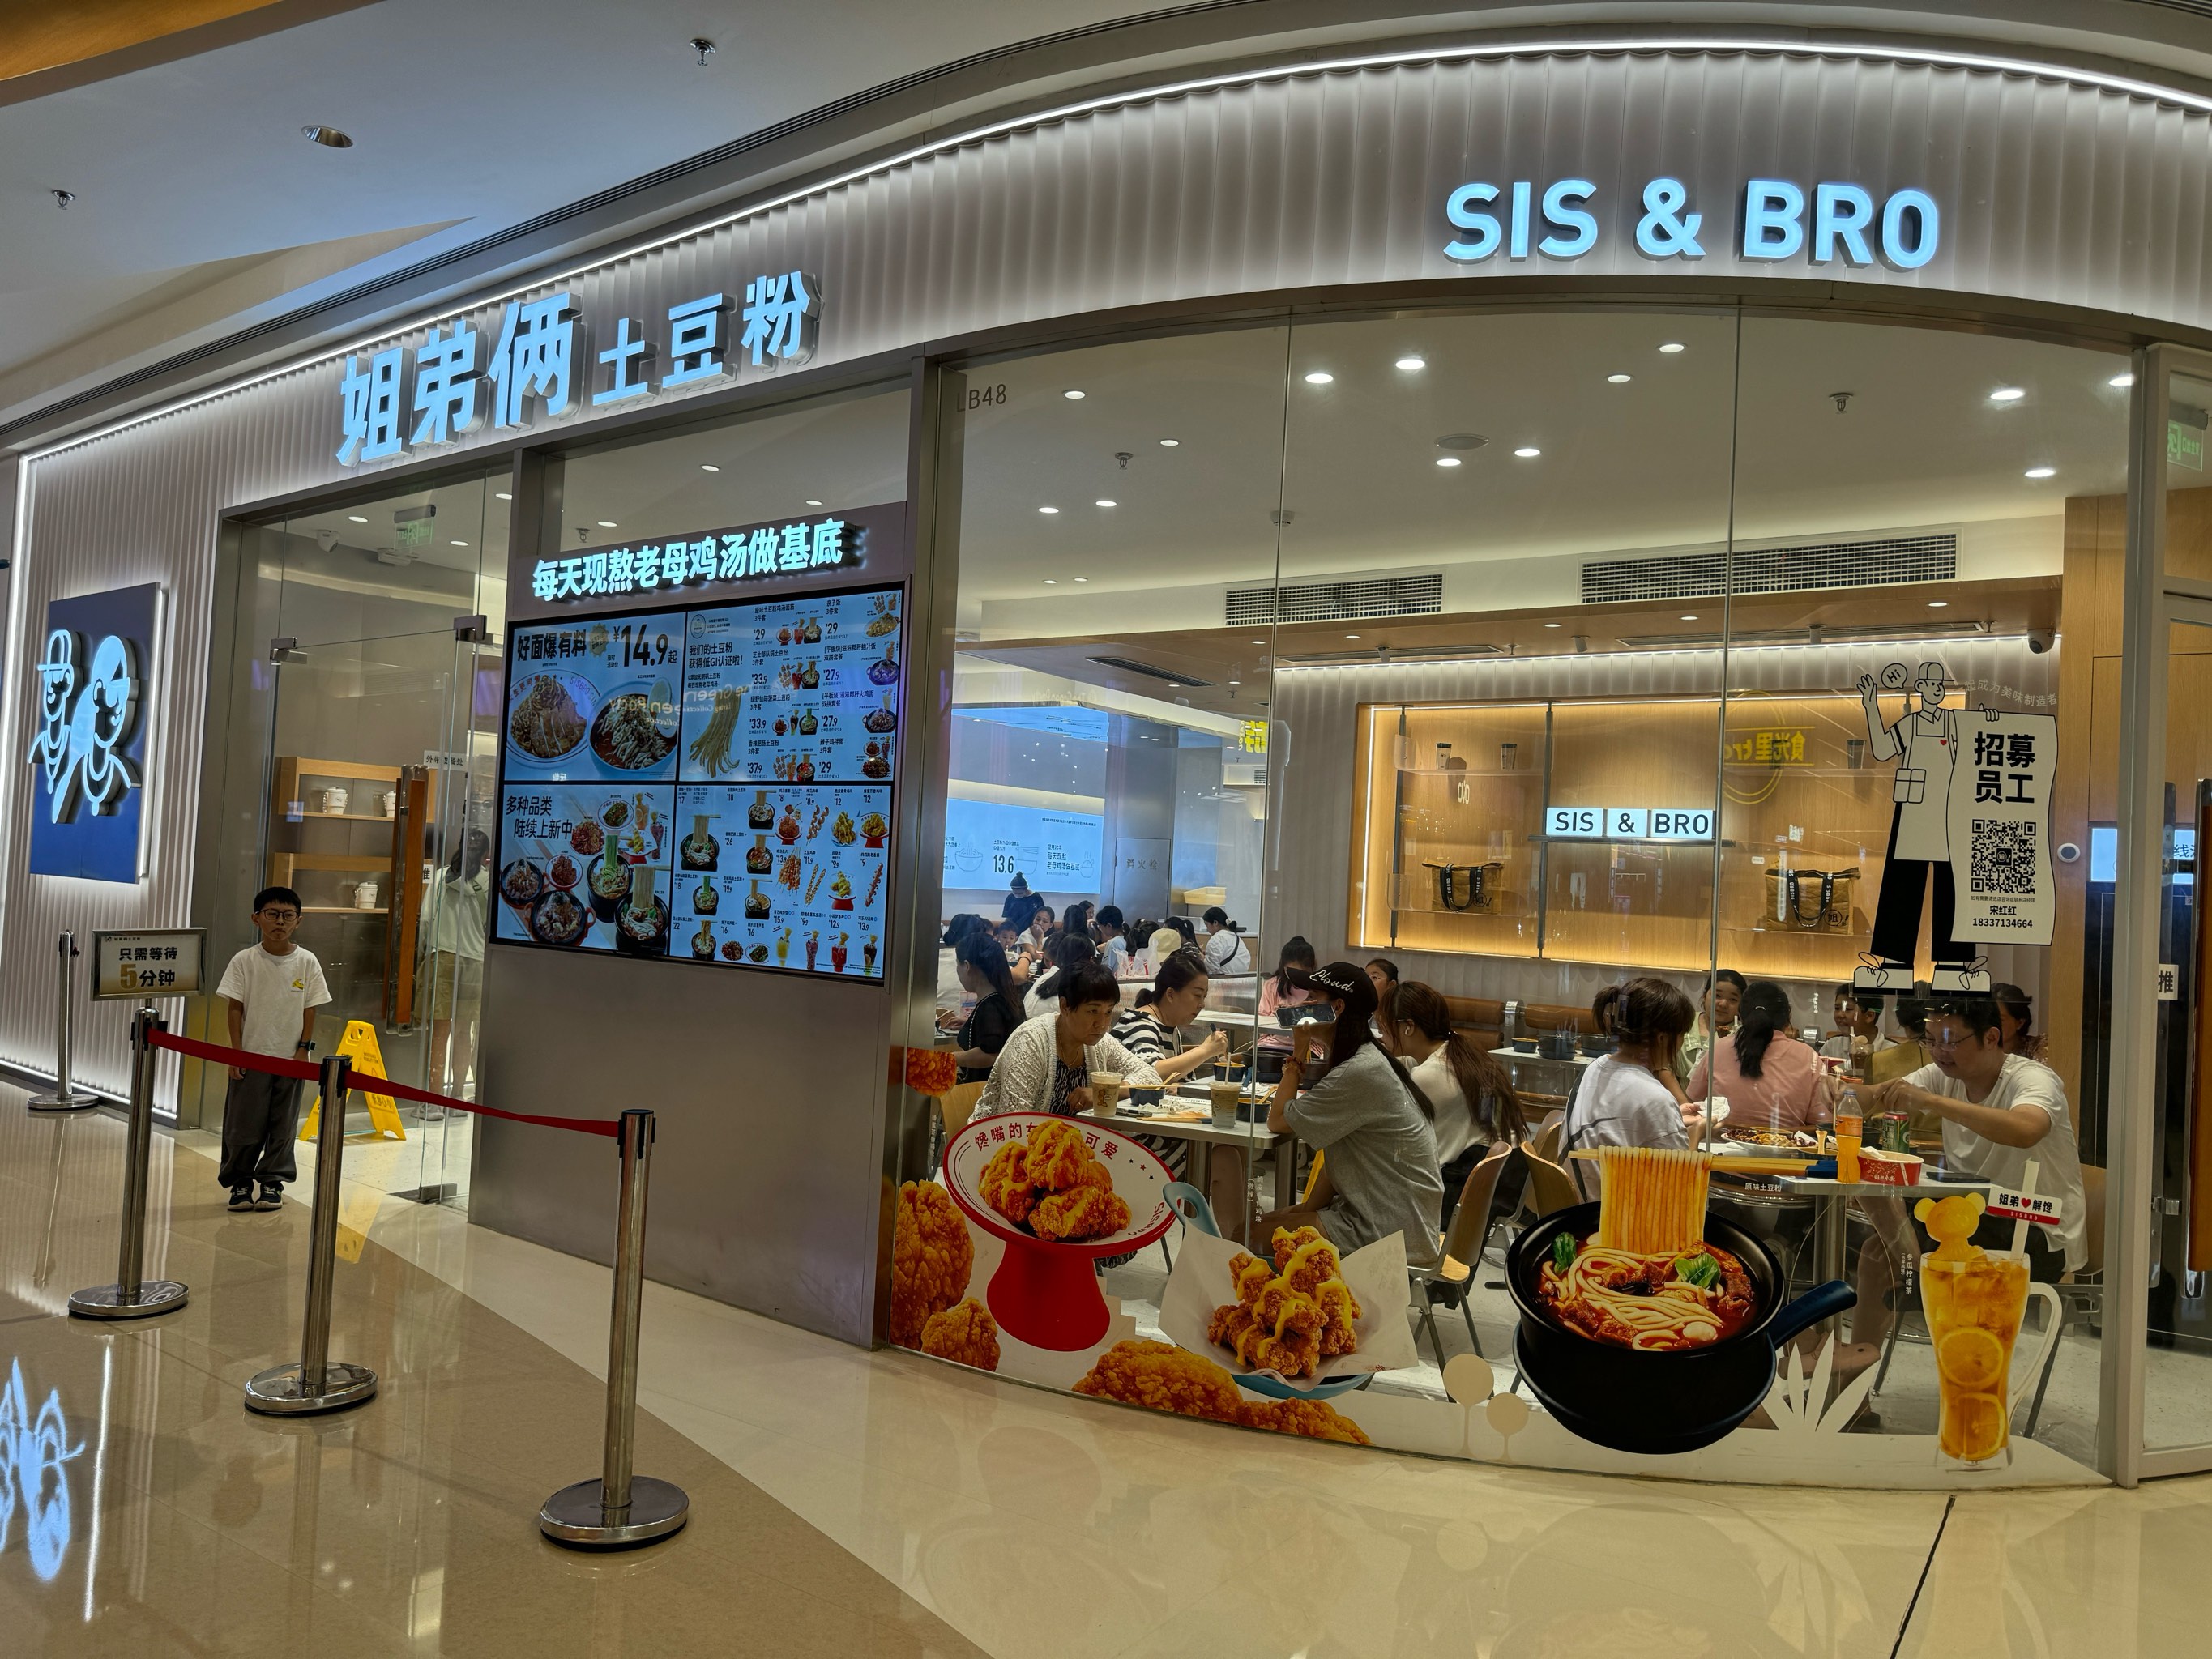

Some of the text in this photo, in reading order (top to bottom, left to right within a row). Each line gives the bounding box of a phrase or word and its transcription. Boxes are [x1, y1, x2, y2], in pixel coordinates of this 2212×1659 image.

[1444, 179, 1938, 268] SIS & BRO
[533, 519, 846, 603] 每天现熬老母鸡汤做基底
[518, 629, 587, 661] 好面爆有料
[690, 642, 732, 655] 我们的土豆粉
[1886, 668, 1902, 682] Hi
[1974, 731, 2036, 768] 招募
[1974, 770, 2035, 804] 员工
[506, 795, 552, 817] 多种品类
[514, 819, 573, 839] 陆续上新中
[1555, 812, 1709, 834] SIS & BRO
[993, 855, 1014, 873] 13.6
[1126, 859, 1157, 869] 消火栓
[1990, 905, 2017, 916] 宋红红
[1972, 918, 2033, 928] 18337134664
[119, 947, 177, 961] 只需等待
[120, 964, 175, 989] 5分钟
[2159, 970, 2174, 995] 推
[1744, 1183, 1782, 1192] 原味土豆粉
[2010, 1211, 2038, 1221] SISBRO
